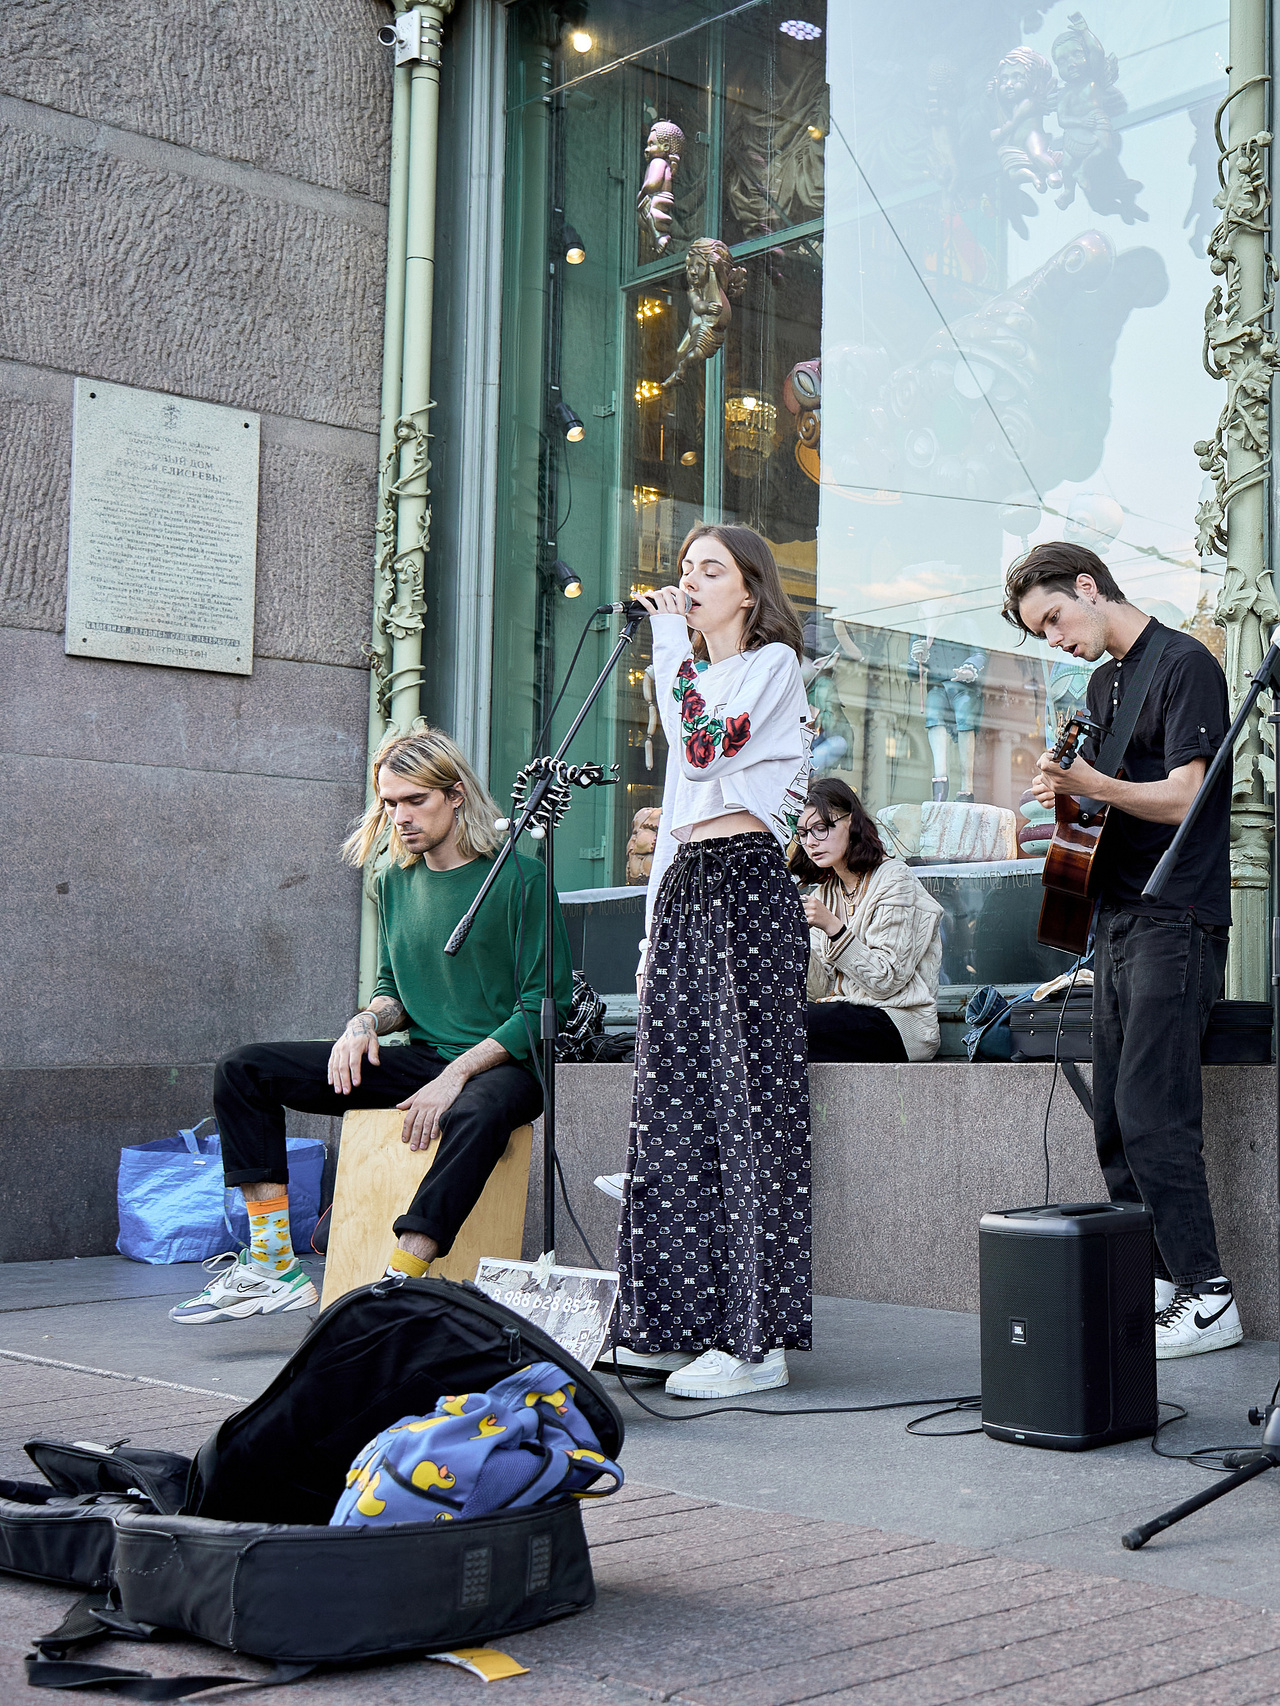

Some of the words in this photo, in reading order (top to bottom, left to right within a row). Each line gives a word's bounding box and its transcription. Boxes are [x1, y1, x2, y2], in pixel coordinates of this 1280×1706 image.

[492, 1288, 501, 1301] 8
[504, 1290, 531, 1308] 988
[533, 1295, 560, 1312] 628
[563, 1297, 580, 1313] 85
